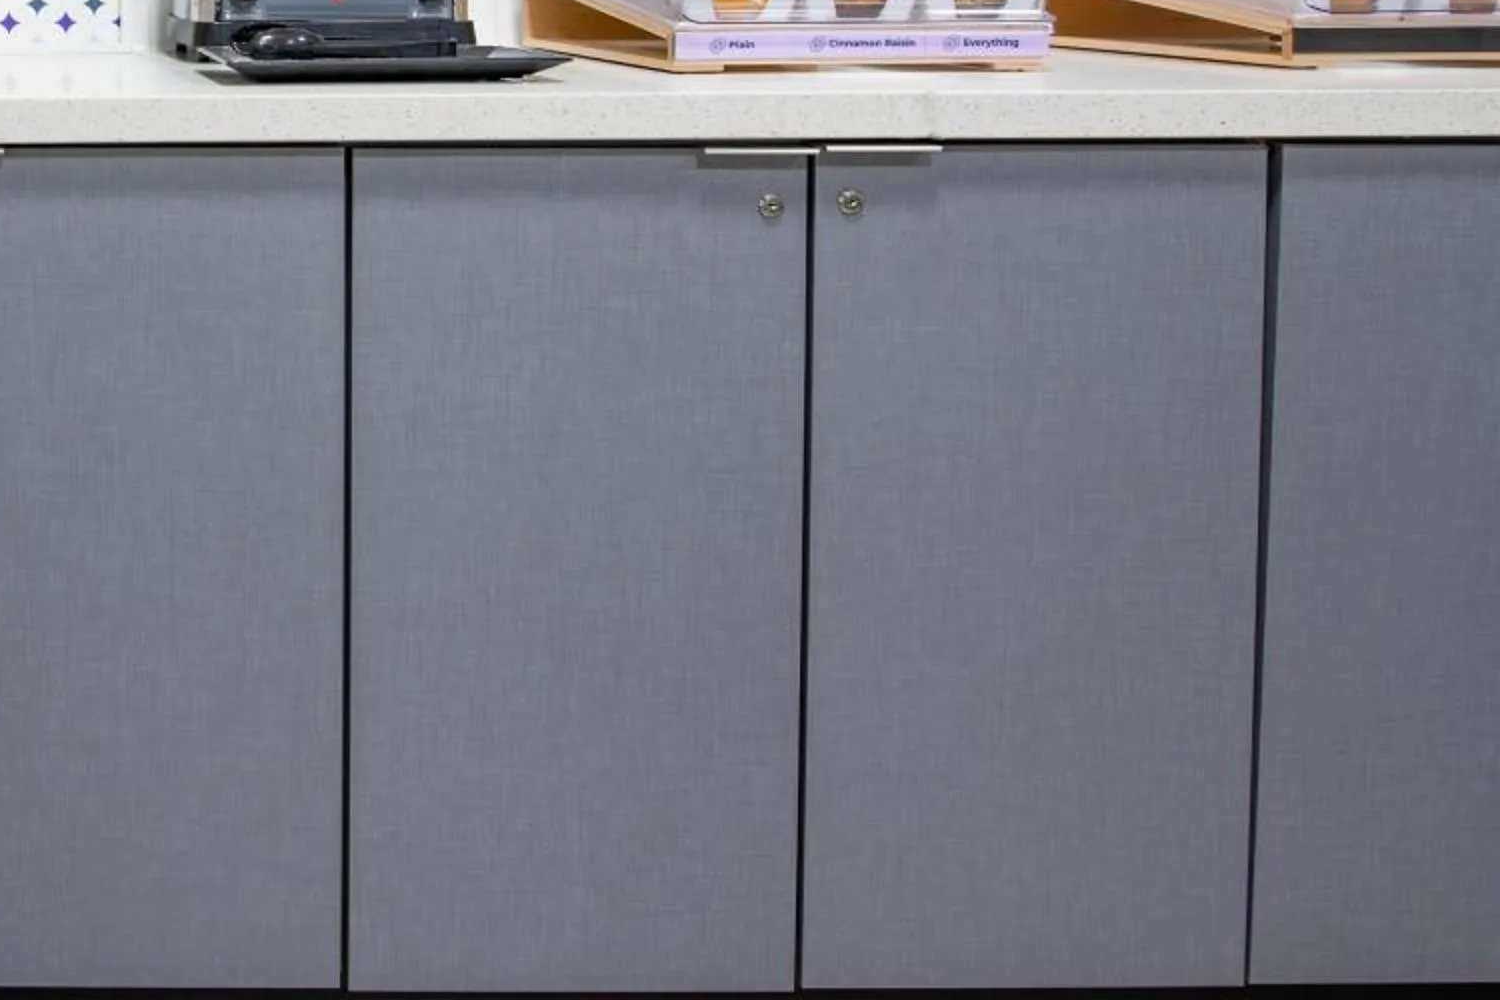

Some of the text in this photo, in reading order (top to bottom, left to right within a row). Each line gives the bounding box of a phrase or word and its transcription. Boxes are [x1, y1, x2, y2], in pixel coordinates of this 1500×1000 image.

[728, 39, 756, 49] Plain
[828, 37, 916, 49] Cinnamon Raisin
[963, 36, 1020, 49] Everything
